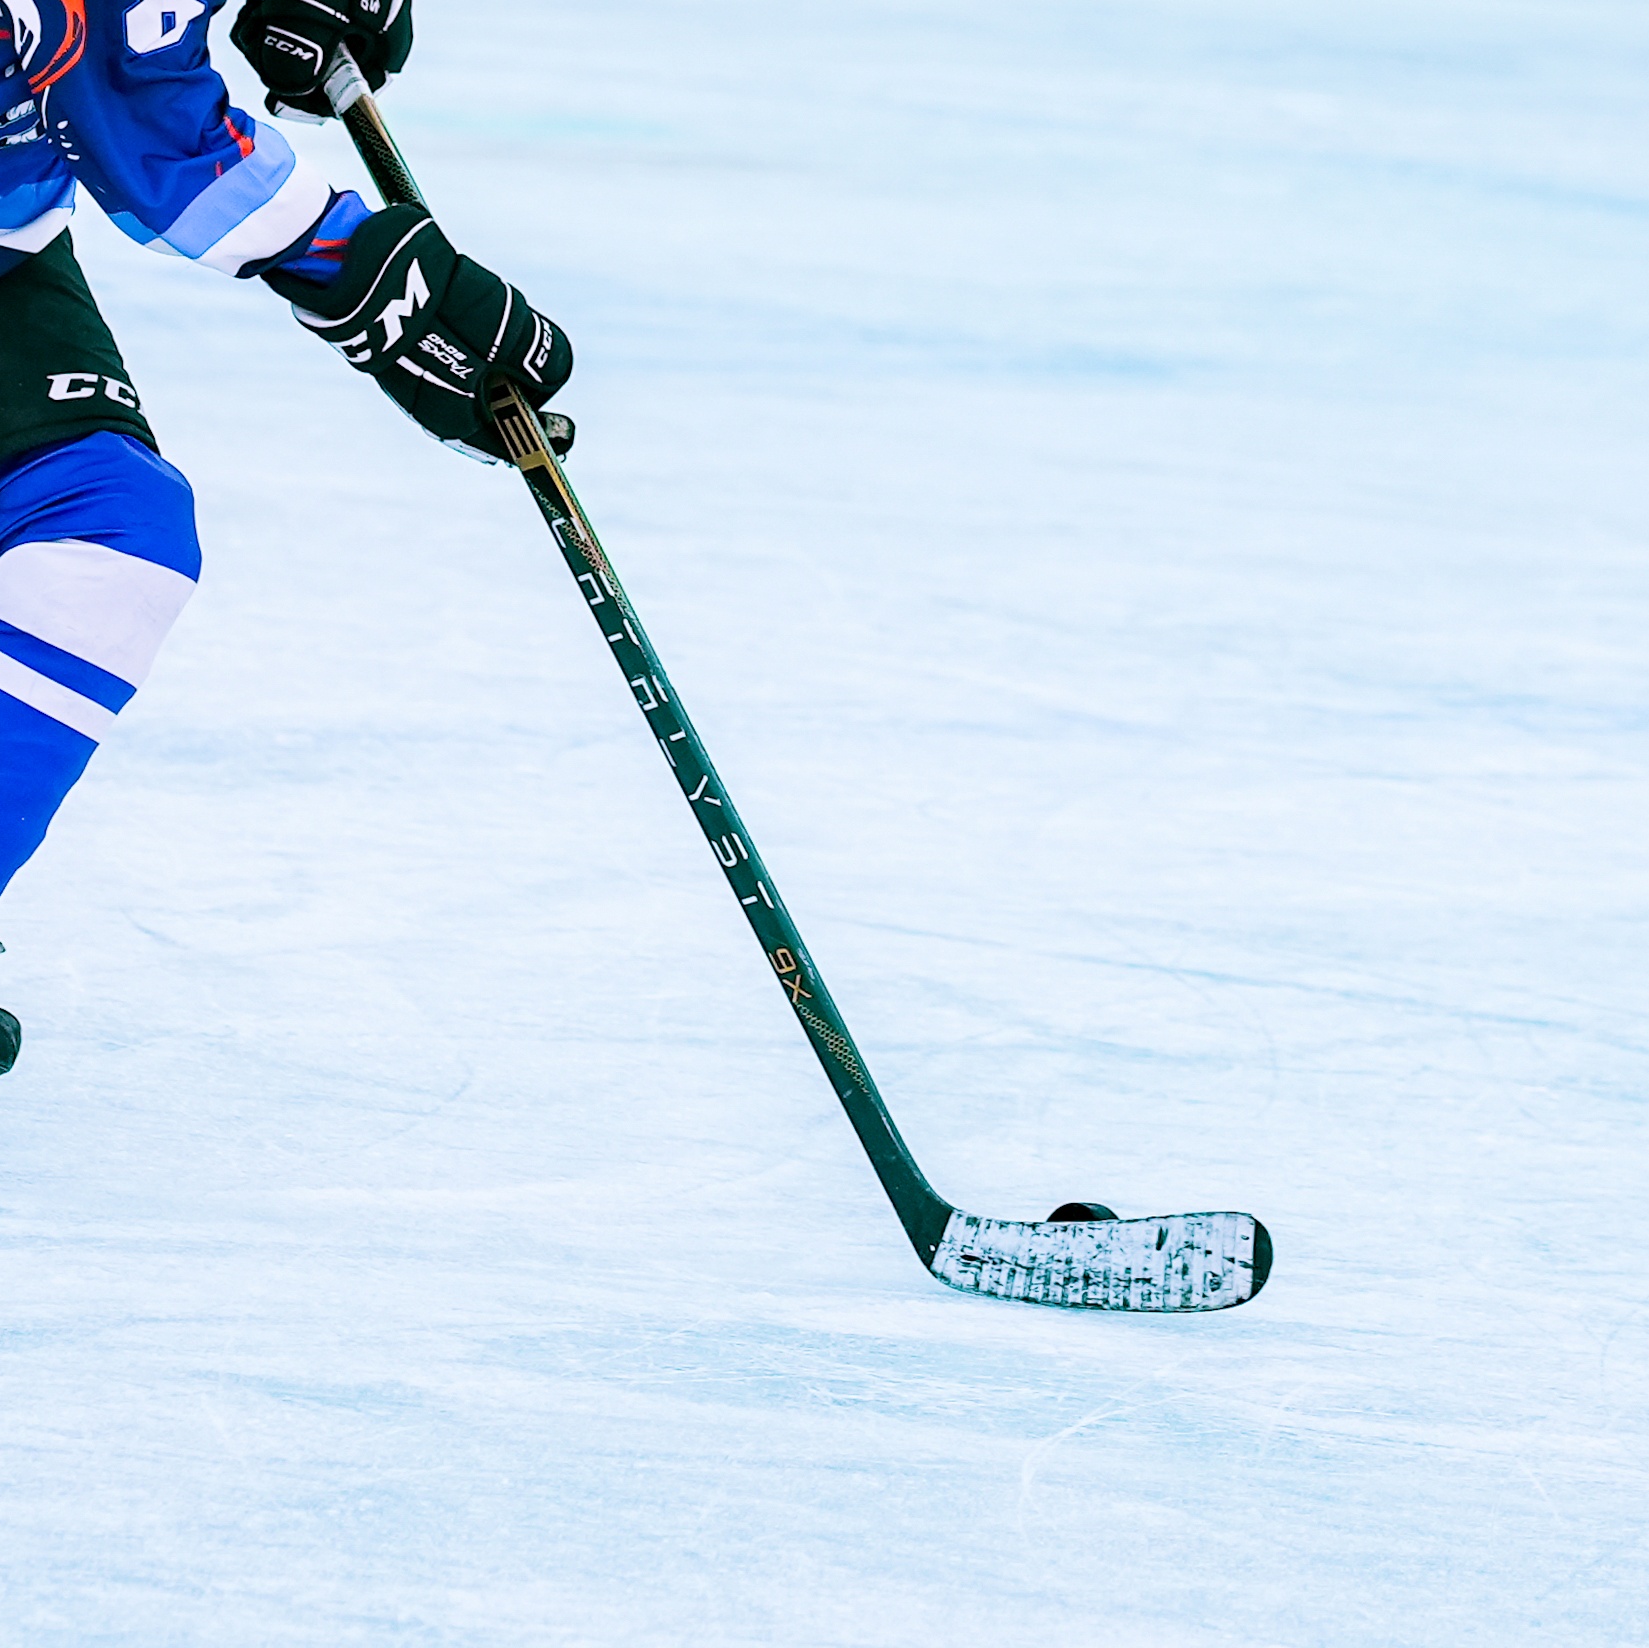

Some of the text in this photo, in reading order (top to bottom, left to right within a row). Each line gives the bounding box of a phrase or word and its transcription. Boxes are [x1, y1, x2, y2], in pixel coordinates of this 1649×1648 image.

[263, 34, 315, 61] CCM
[328, 258, 431, 364] CM
[417, 338, 475, 380] TACKS
[46, 372, 137, 409] CC
[768, 947, 813, 1004] 9X
